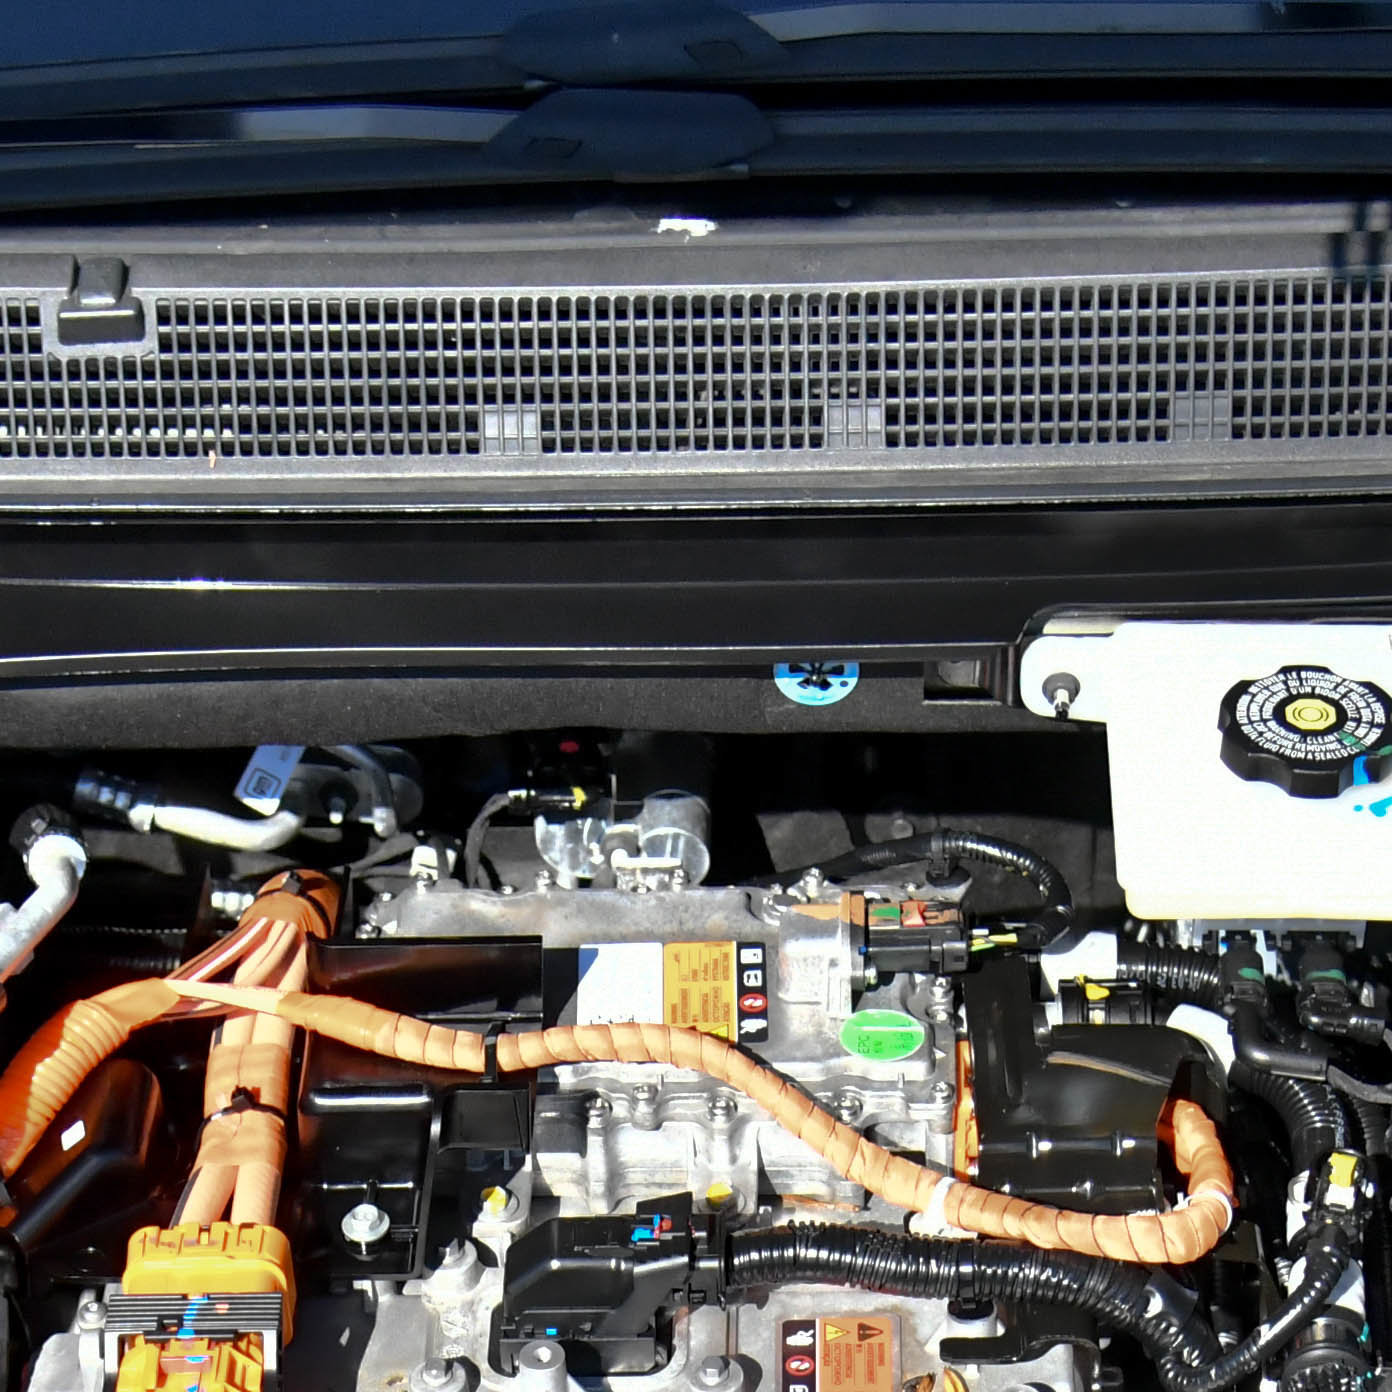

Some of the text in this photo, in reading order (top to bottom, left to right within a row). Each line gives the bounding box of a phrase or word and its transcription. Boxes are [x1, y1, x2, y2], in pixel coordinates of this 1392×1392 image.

[1287, 671, 1297, 680] LE
[1300, 671, 1343, 684] BOUCHON
[1307, 735, 1337, 745] CLEAN
[1279, 746, 1306, 760] FROM
